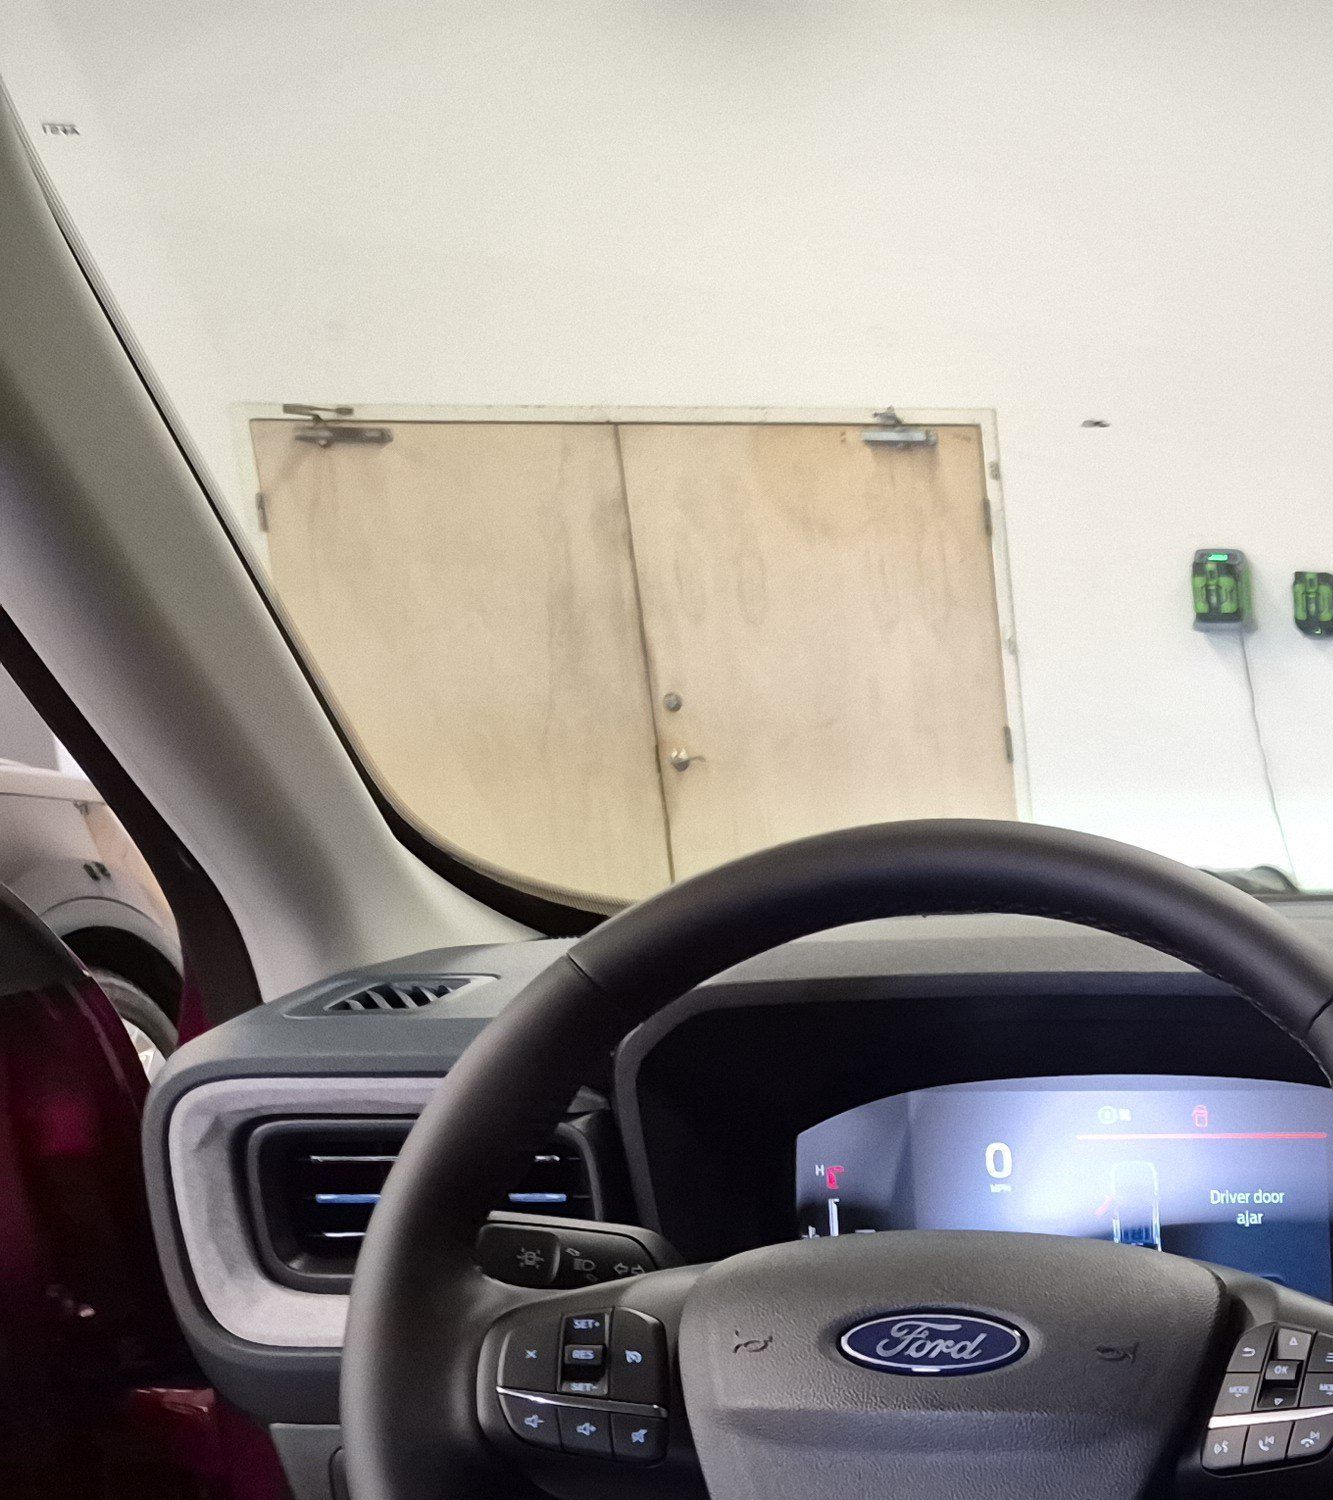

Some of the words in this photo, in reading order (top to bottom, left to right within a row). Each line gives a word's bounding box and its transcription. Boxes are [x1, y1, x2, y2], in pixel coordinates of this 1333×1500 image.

[985, 1142, 1012, 1179] 0
[1210, 1189, 1251, 1205] Driver
[1253, 1188, 1285, 1204] door
[1236, 1209, 1264, 1228] ajar
[876, 1321, 987, 1360] Ford
[1274, 1365, 1289, 1375] OK
